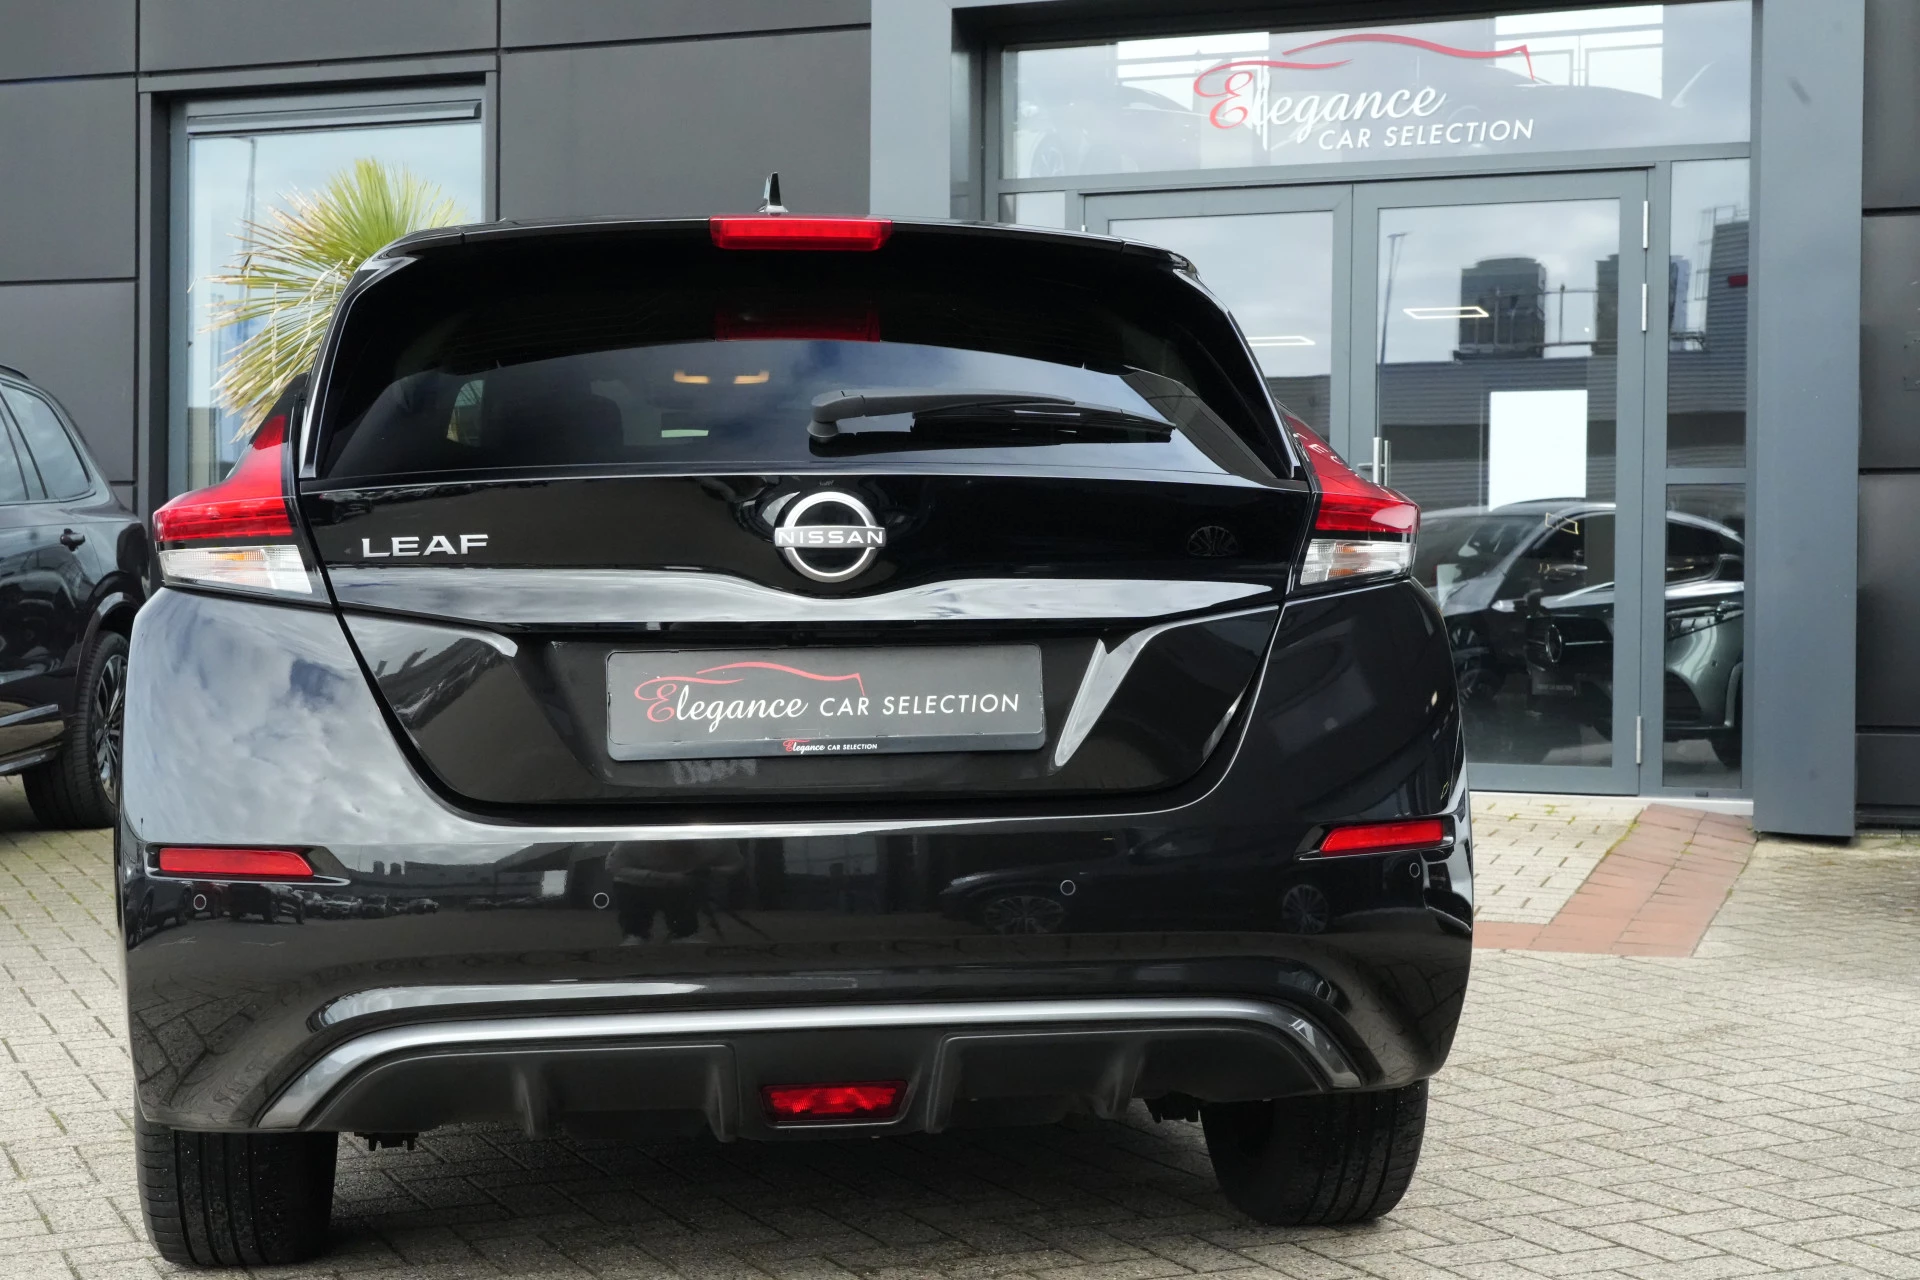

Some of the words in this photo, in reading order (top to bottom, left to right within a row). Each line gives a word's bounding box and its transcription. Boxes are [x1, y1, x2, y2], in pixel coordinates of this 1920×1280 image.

[1194, 61, 1446, 144] Elegance
[1318, 127, 1370, 151] CAR
[1383, 119, 1534, 147] SELECTION
[361, 533, 489, 558] LEAF
[777, 528, 884, 546] NISSAN
[634, 676, 809, 733] Elegance
[819, 697, 869, 717] CAR
[882, 693, 1020, 715] SELECTION
[783, 739, 825, 754] Elegance
[842, 743, 878, 751] SELECTION
